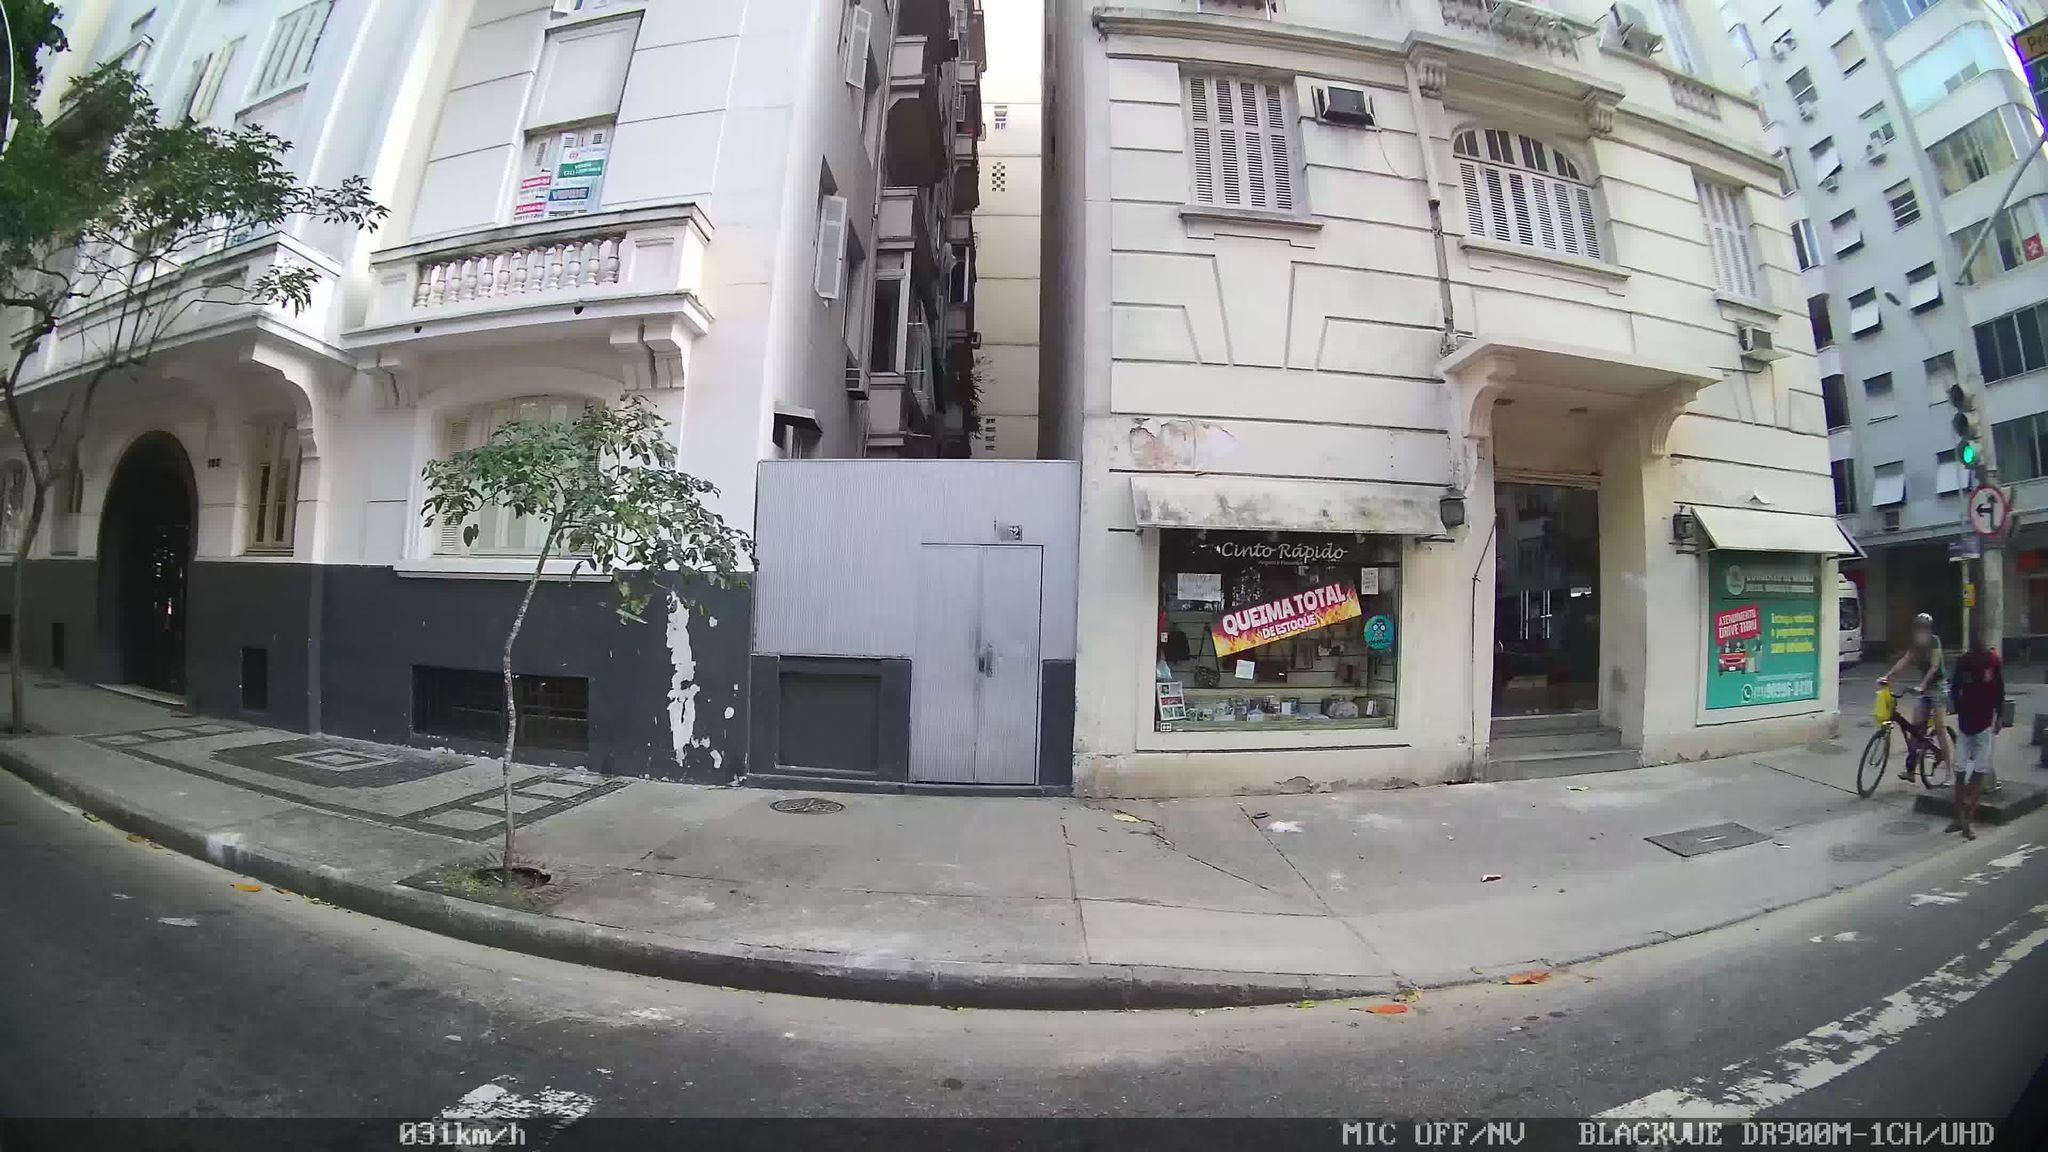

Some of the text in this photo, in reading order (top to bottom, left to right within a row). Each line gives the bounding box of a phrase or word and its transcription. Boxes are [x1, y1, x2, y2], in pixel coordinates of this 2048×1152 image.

[1221, 542, 1348, 563] Cinto Rápido
[1222, 583, 1346, 636] QUEIMA TOTAL
[1262, 614, 1317, 640] DE ESTOQUE
